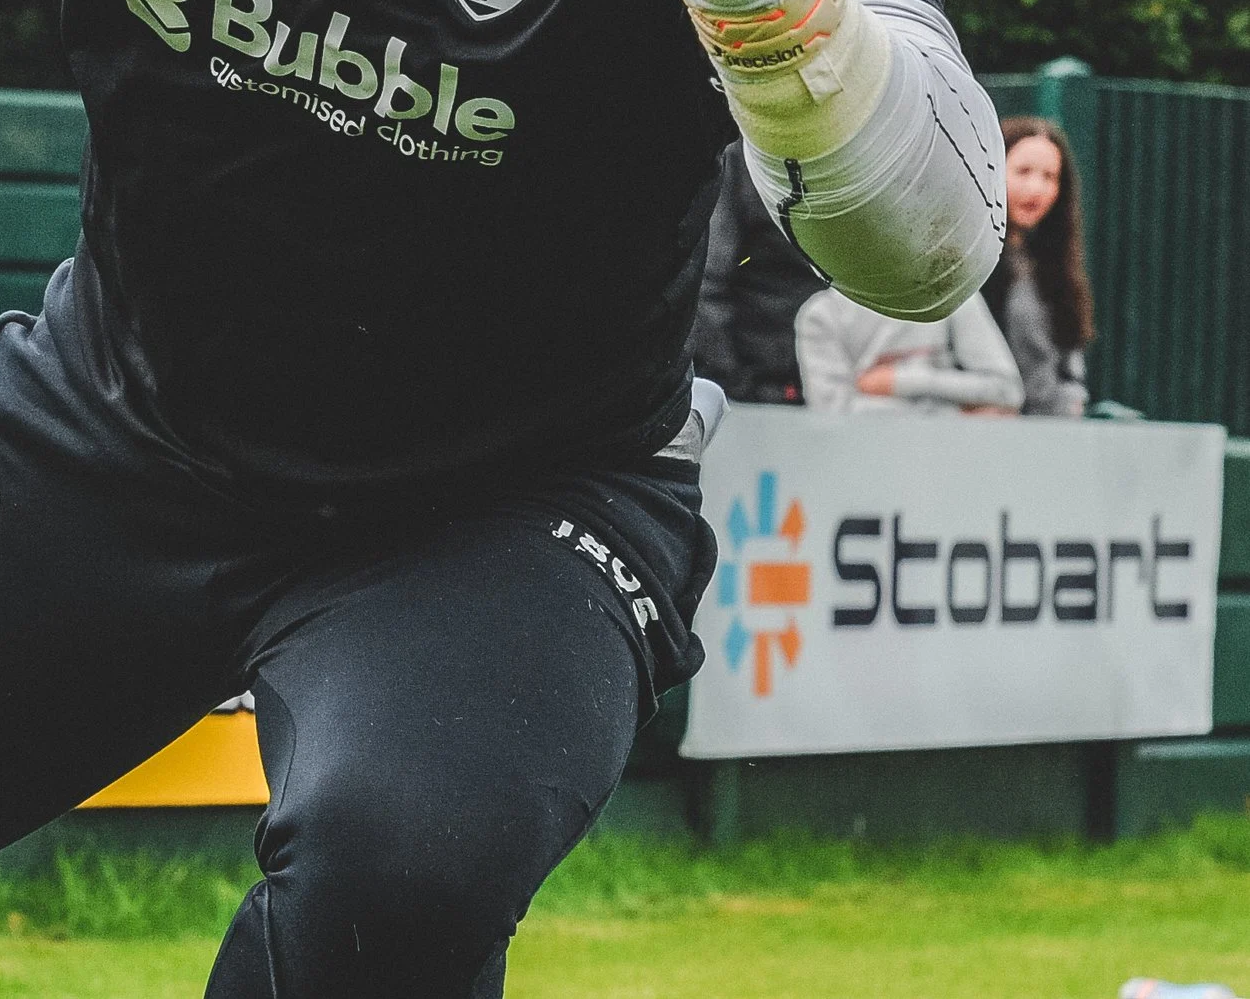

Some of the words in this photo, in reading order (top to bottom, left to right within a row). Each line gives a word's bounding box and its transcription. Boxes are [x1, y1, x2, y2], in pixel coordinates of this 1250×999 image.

[210, 56, 366, 137] customised
[377, 122, 503, 166] clothing
[831, 509, 1192, 628] Stobart
